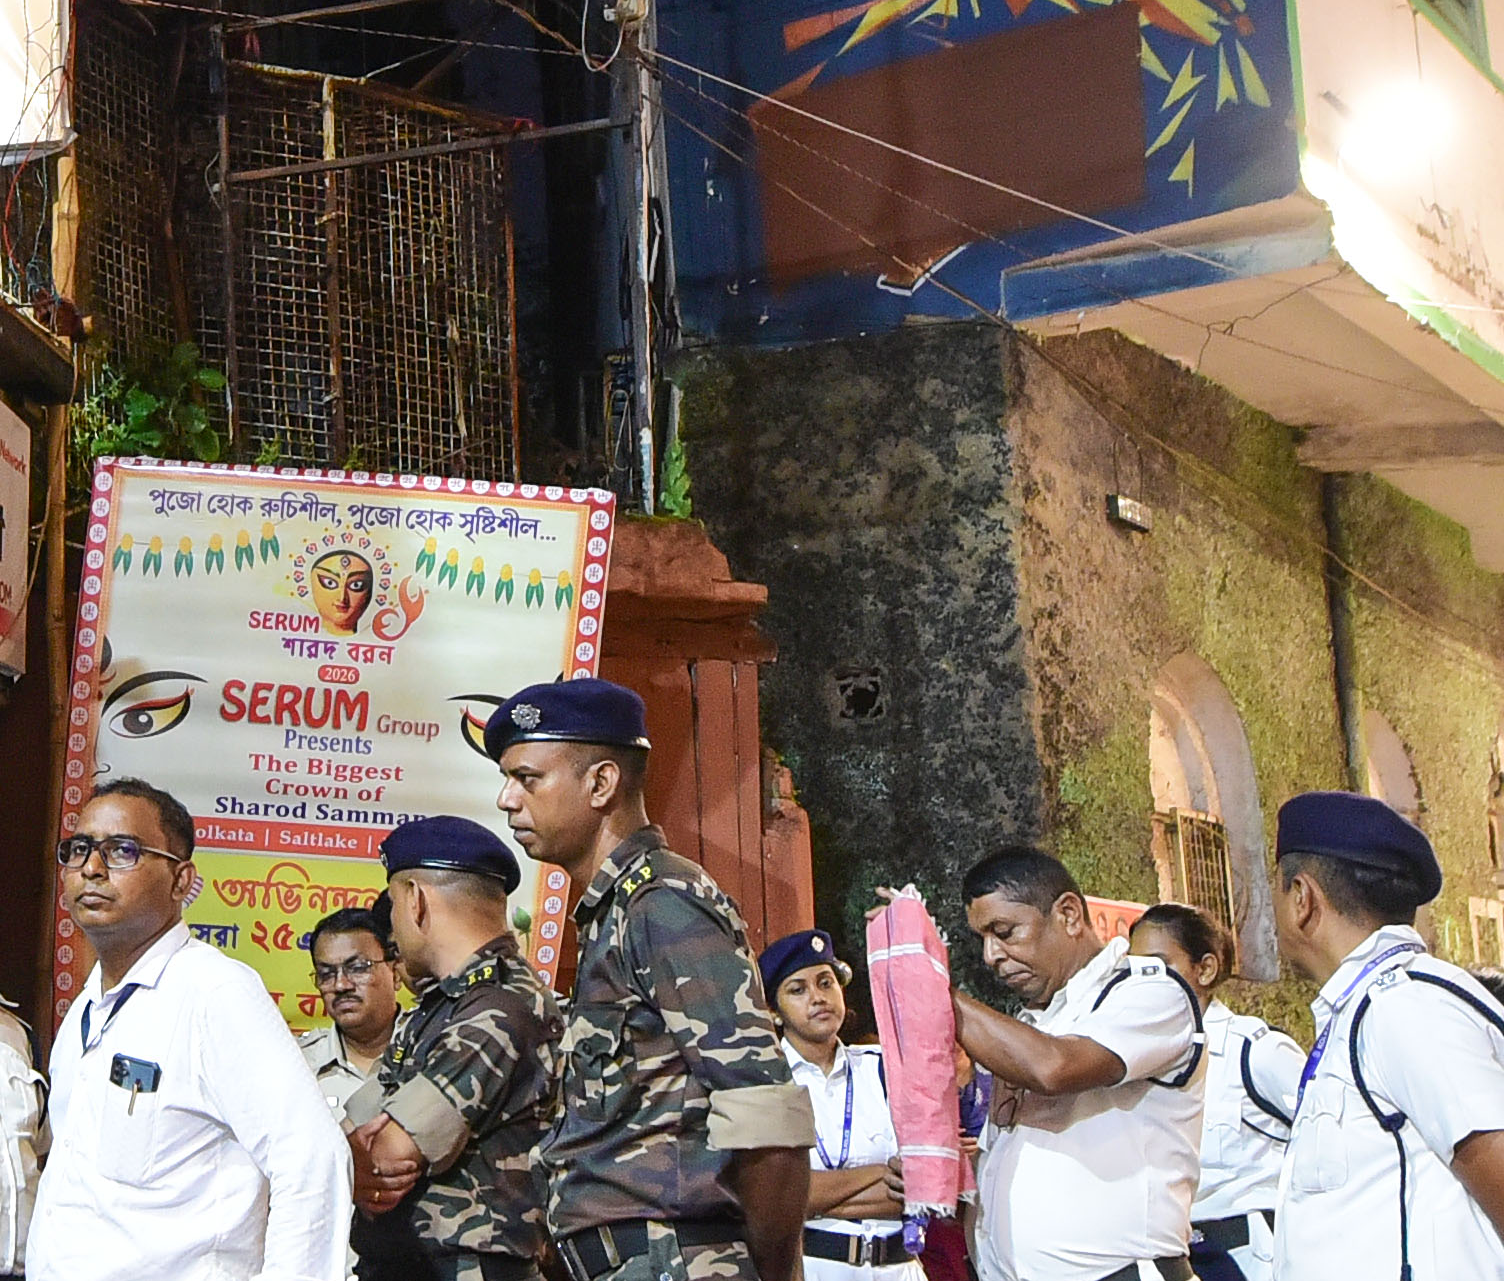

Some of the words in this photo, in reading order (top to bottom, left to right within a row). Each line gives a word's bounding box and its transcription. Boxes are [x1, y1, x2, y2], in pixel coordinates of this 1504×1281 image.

[0, 436, 27, 477] Network
[149, 487, 202, 517] পুজো
[207, 490, 253, 516] হোক
[347, 500, 401, 535] পুজো
[405, 504, 454, 532] হোক
[248, 610, 320, 635] SERUM
[324, 667, 356, 683] 2026
[220, 679, 370, 733] SERUM
[376, 714, 441, 742] Group
[283, 728, 374, 756] Presents
[250, 753, 299, 776] The
[307, 758, 404, 784] Biggest
[265, 778, 350, 802] Crown
[356, 784, 386, 803] of
[214, 796, 307, 821] Sharod
[196, 827, 255, 843] olkata
[279, 828, 359, 850] Saltlake
